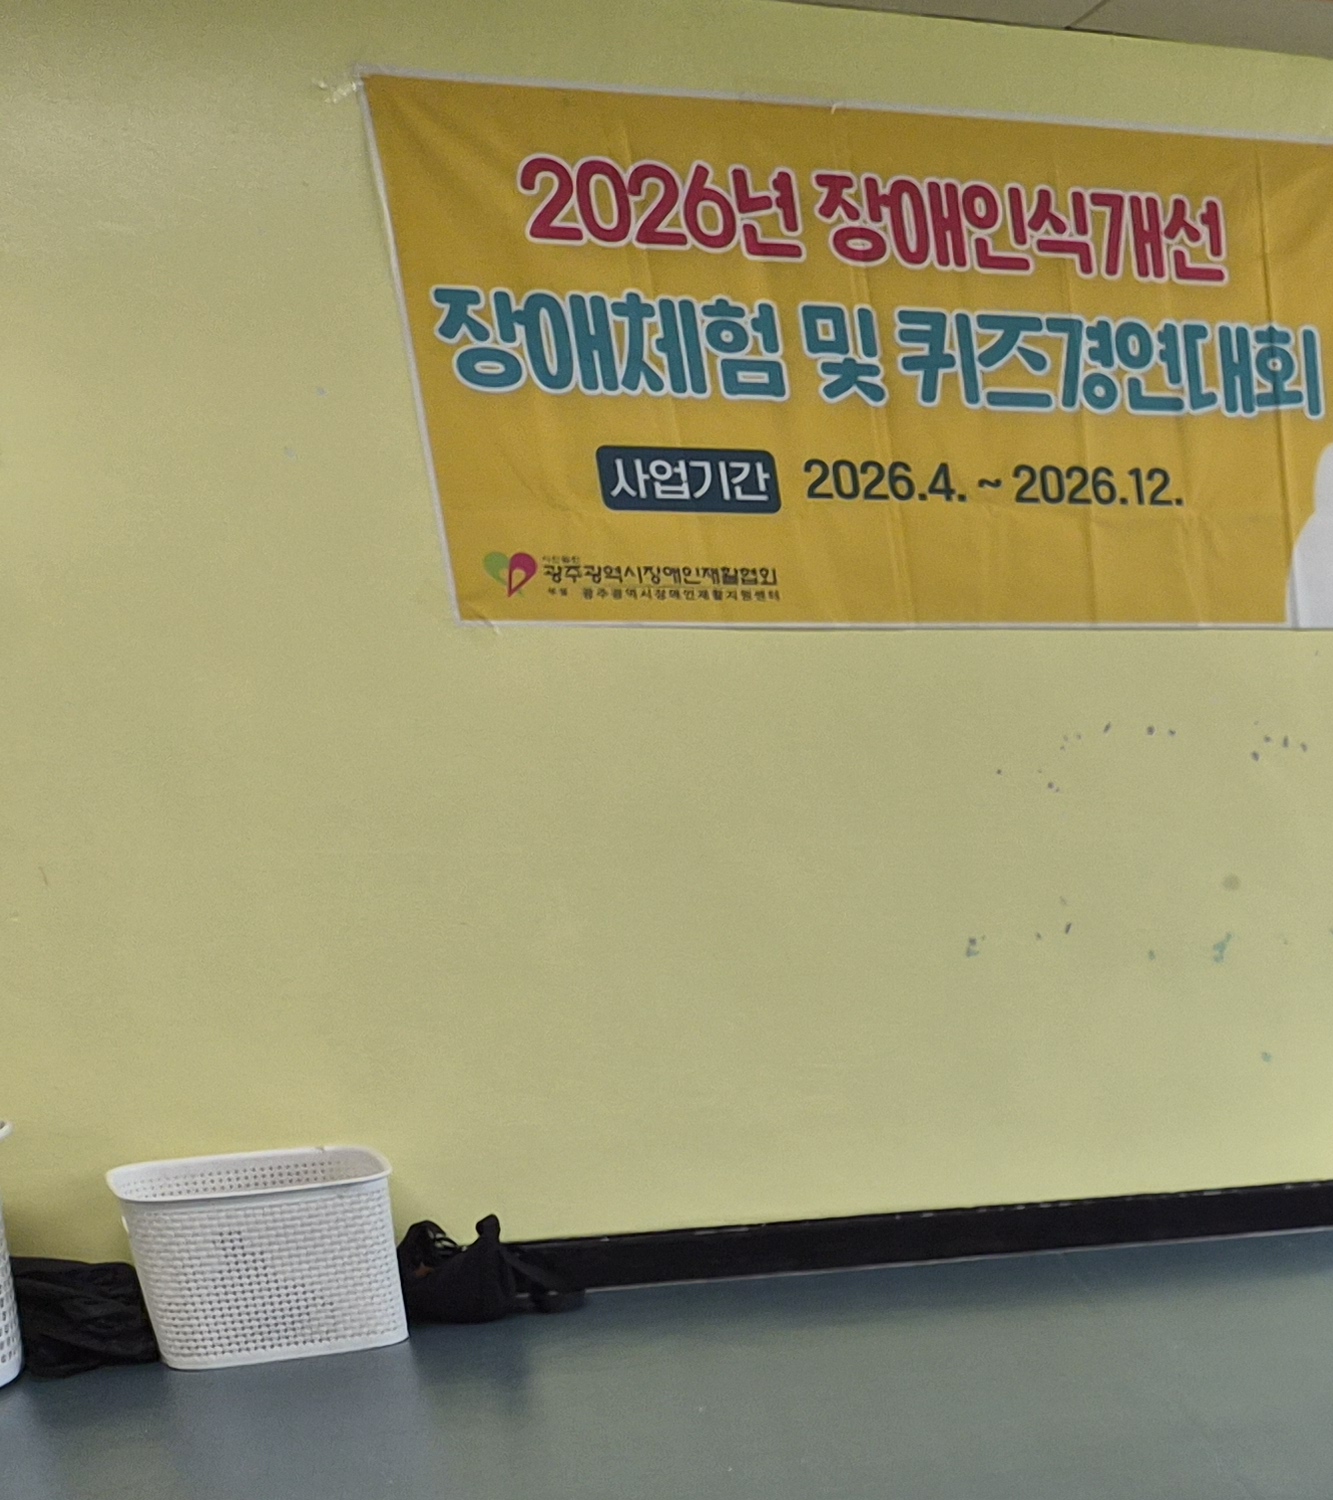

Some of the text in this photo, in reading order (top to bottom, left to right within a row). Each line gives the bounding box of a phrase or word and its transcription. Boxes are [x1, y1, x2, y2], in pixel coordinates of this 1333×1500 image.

[518, 157, 1227, 283] 2026년 장애인식개선
[431, 286, 1324, 417] 장애체험 및 퀴즈경연대회
[608, 458, 771, 503] 사업기간
[803, 459, 966, 502] 2026.4.
[1012, 464, 1184, 506] 2026.12.
[543, 565, 778, 585] 광주광역시장애인재활협회
